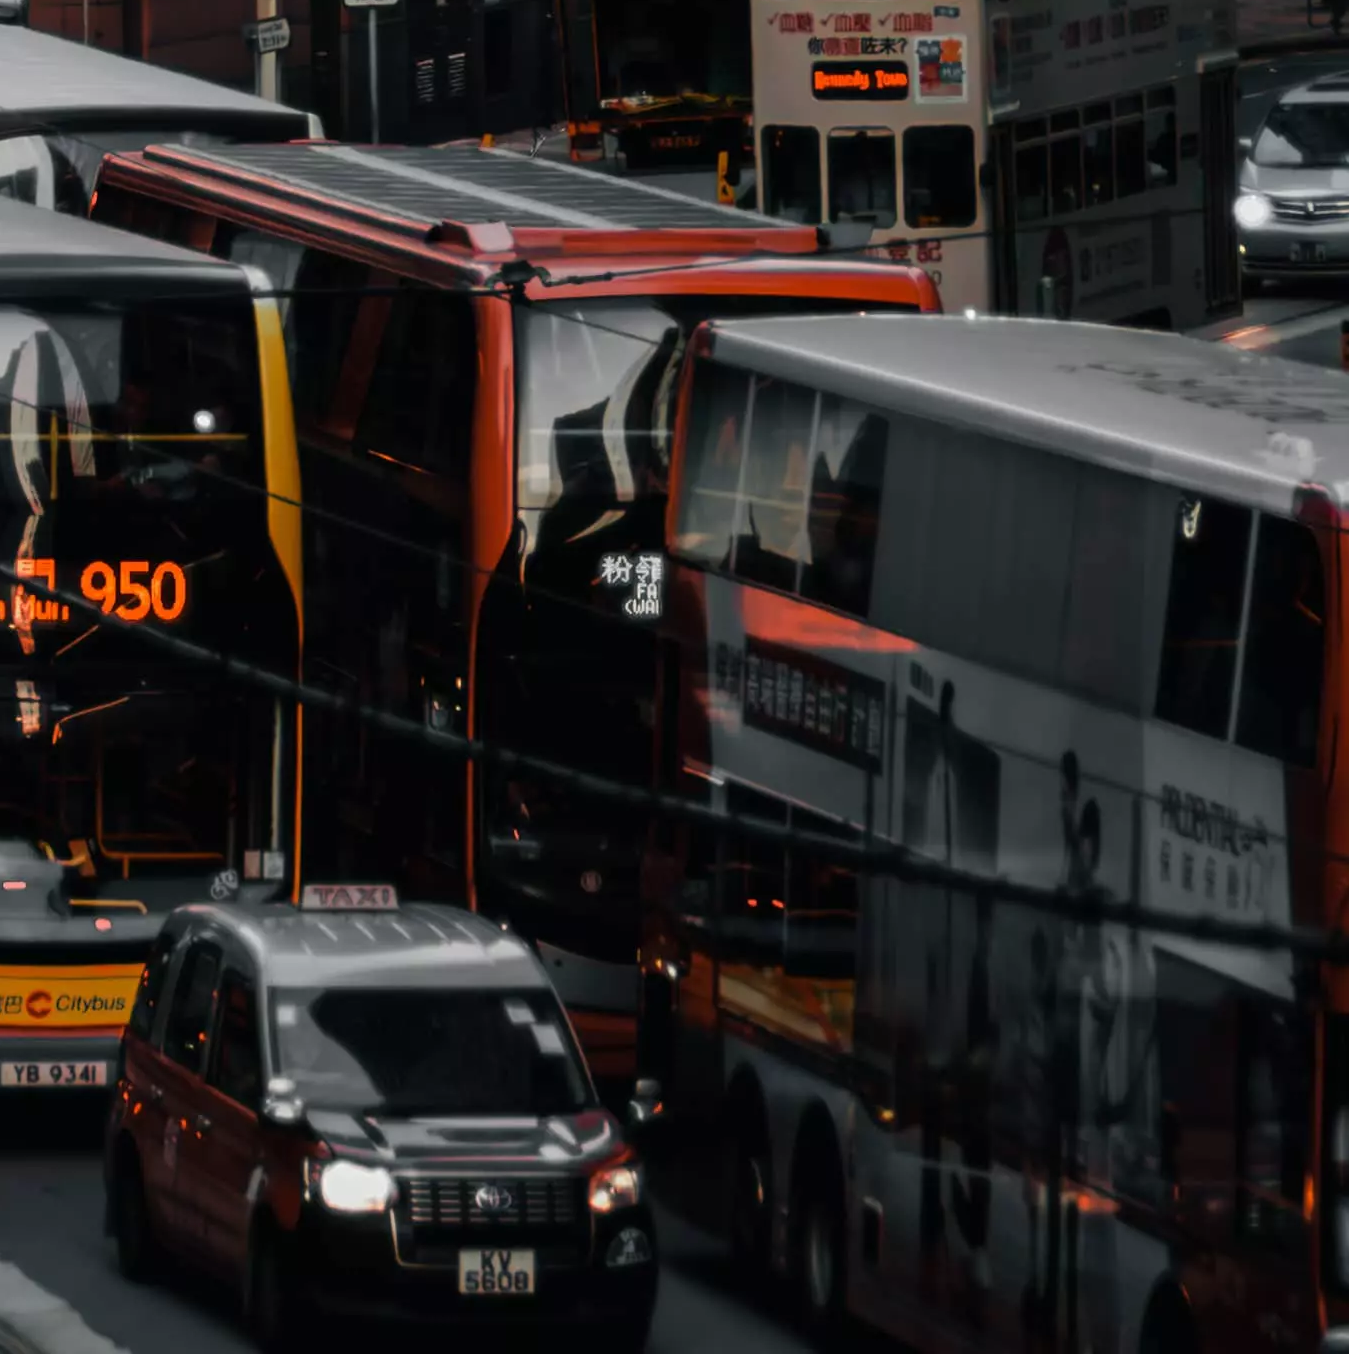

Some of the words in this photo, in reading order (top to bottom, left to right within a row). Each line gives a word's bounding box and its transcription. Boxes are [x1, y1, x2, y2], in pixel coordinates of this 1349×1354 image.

[81, 561, 186, 621] 950
[312, 887, 391, 907] TAXI
[55, 994, 126, 1013] Citybus
[14, 1064, 40, 1084] YB
[50, 1064, 97, 1084] 9341
